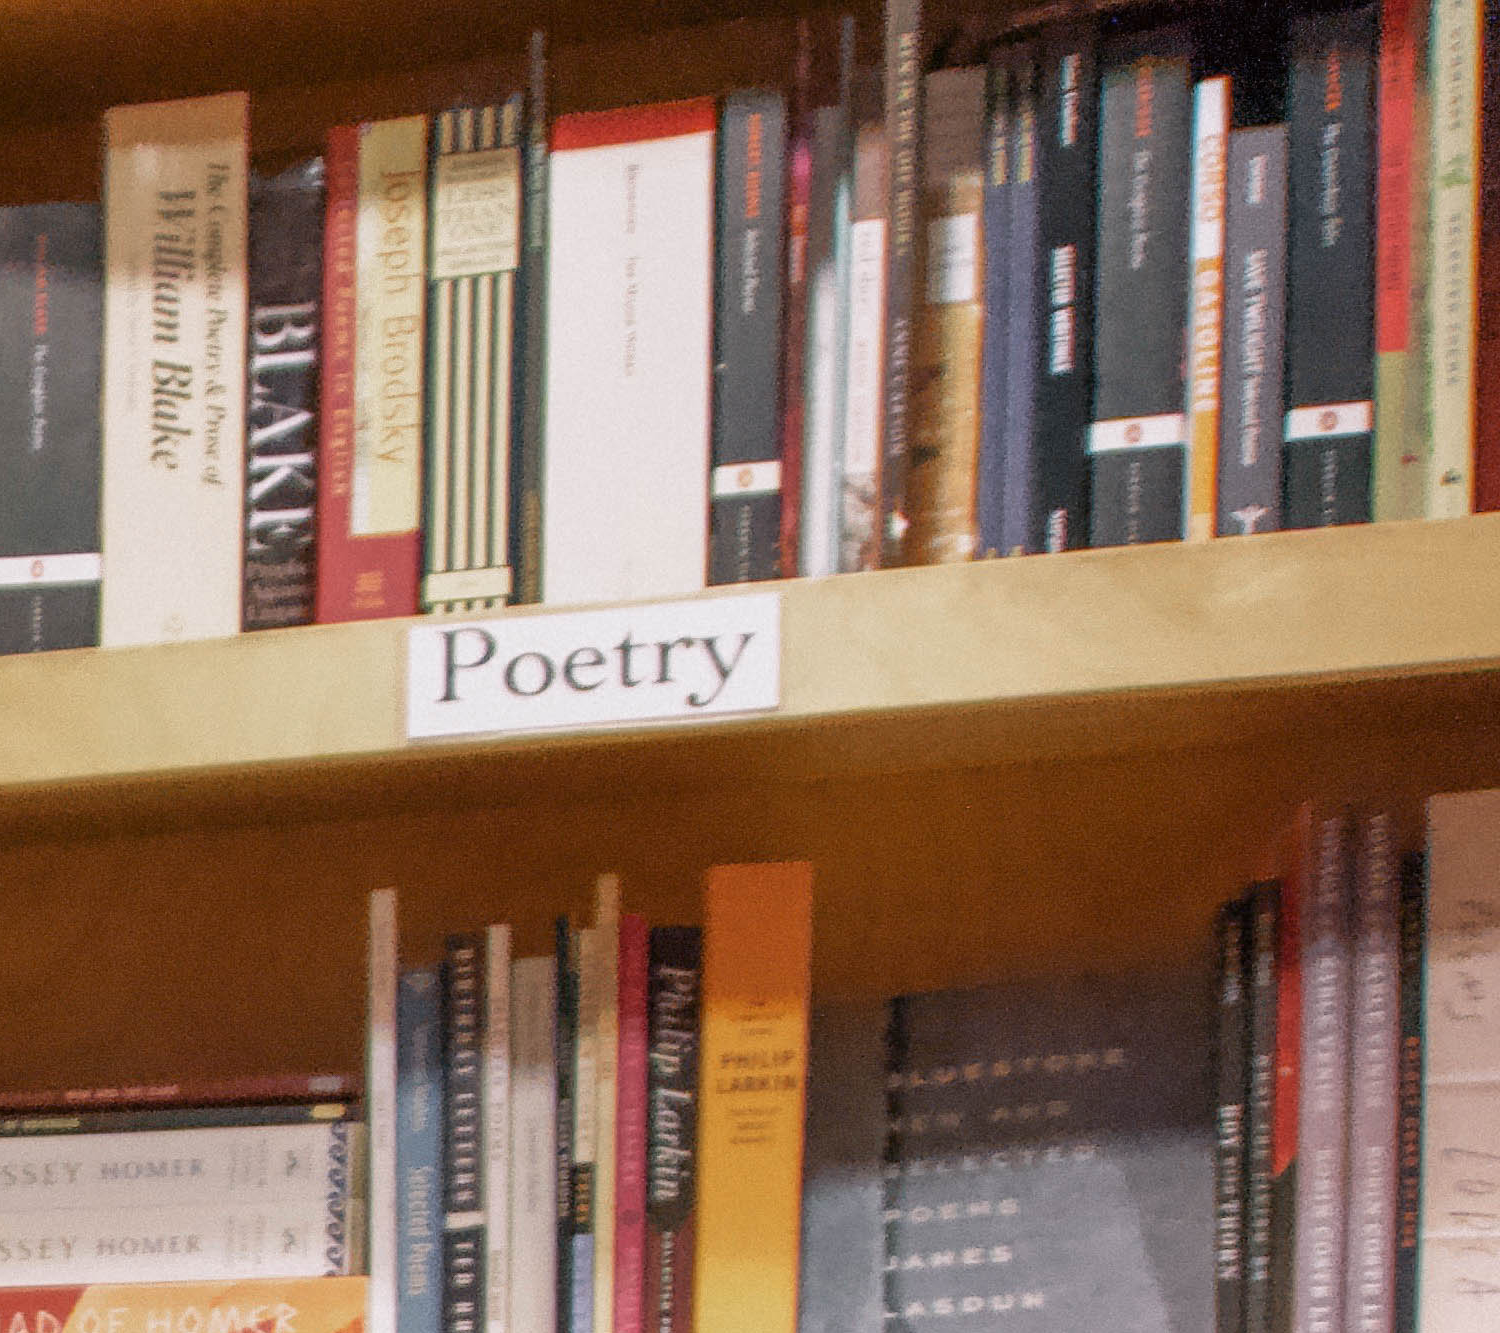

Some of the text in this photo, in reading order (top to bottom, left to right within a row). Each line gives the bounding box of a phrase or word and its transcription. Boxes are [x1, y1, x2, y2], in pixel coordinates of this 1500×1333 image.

[150, 188, 197, 472] William Blake
[248, 303, 314, 550] BLAKE
[436, 625, 754, 707] Poetry
[100, 1156, 206, 1183] HOMER
[649, 966, 694, 1202] Philip Larkin
